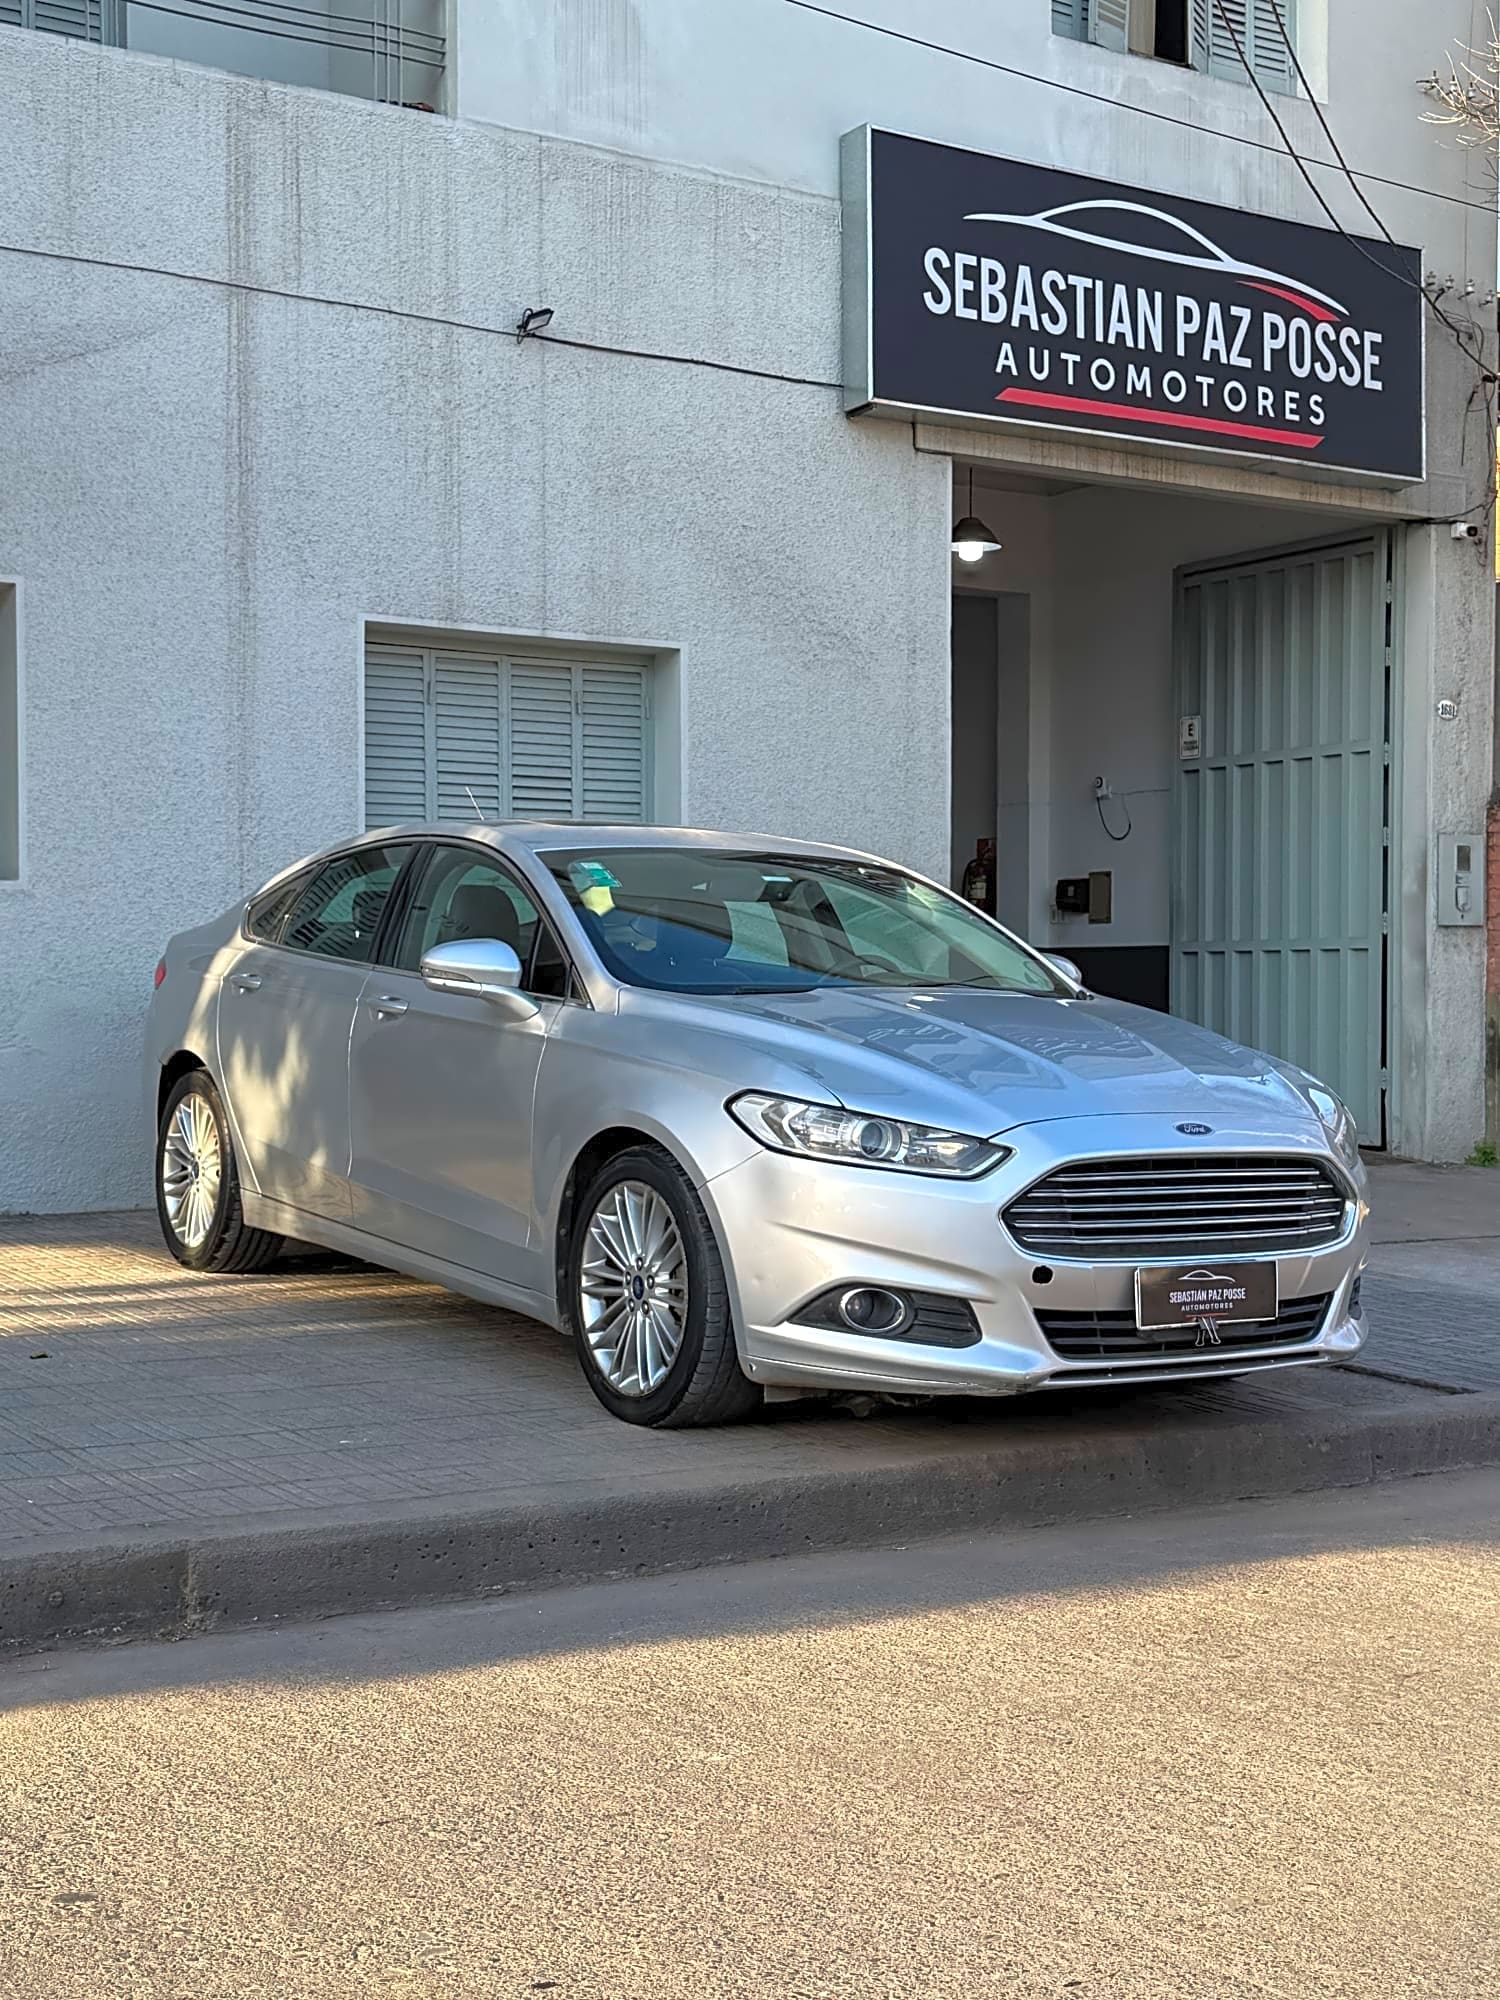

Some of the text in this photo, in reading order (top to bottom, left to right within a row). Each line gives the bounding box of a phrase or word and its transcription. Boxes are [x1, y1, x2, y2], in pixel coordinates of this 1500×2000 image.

[923, 247, 1384, 391] SEBASTIAN PAZ POSSE
[995, 342, 1326, 425] AUTOMOTORES
[1169, 1287, 1246, 1303] SEBASTIAN PAZ POSSE
[1181, 1302, 1233, 1312] AUTOMOTORES
